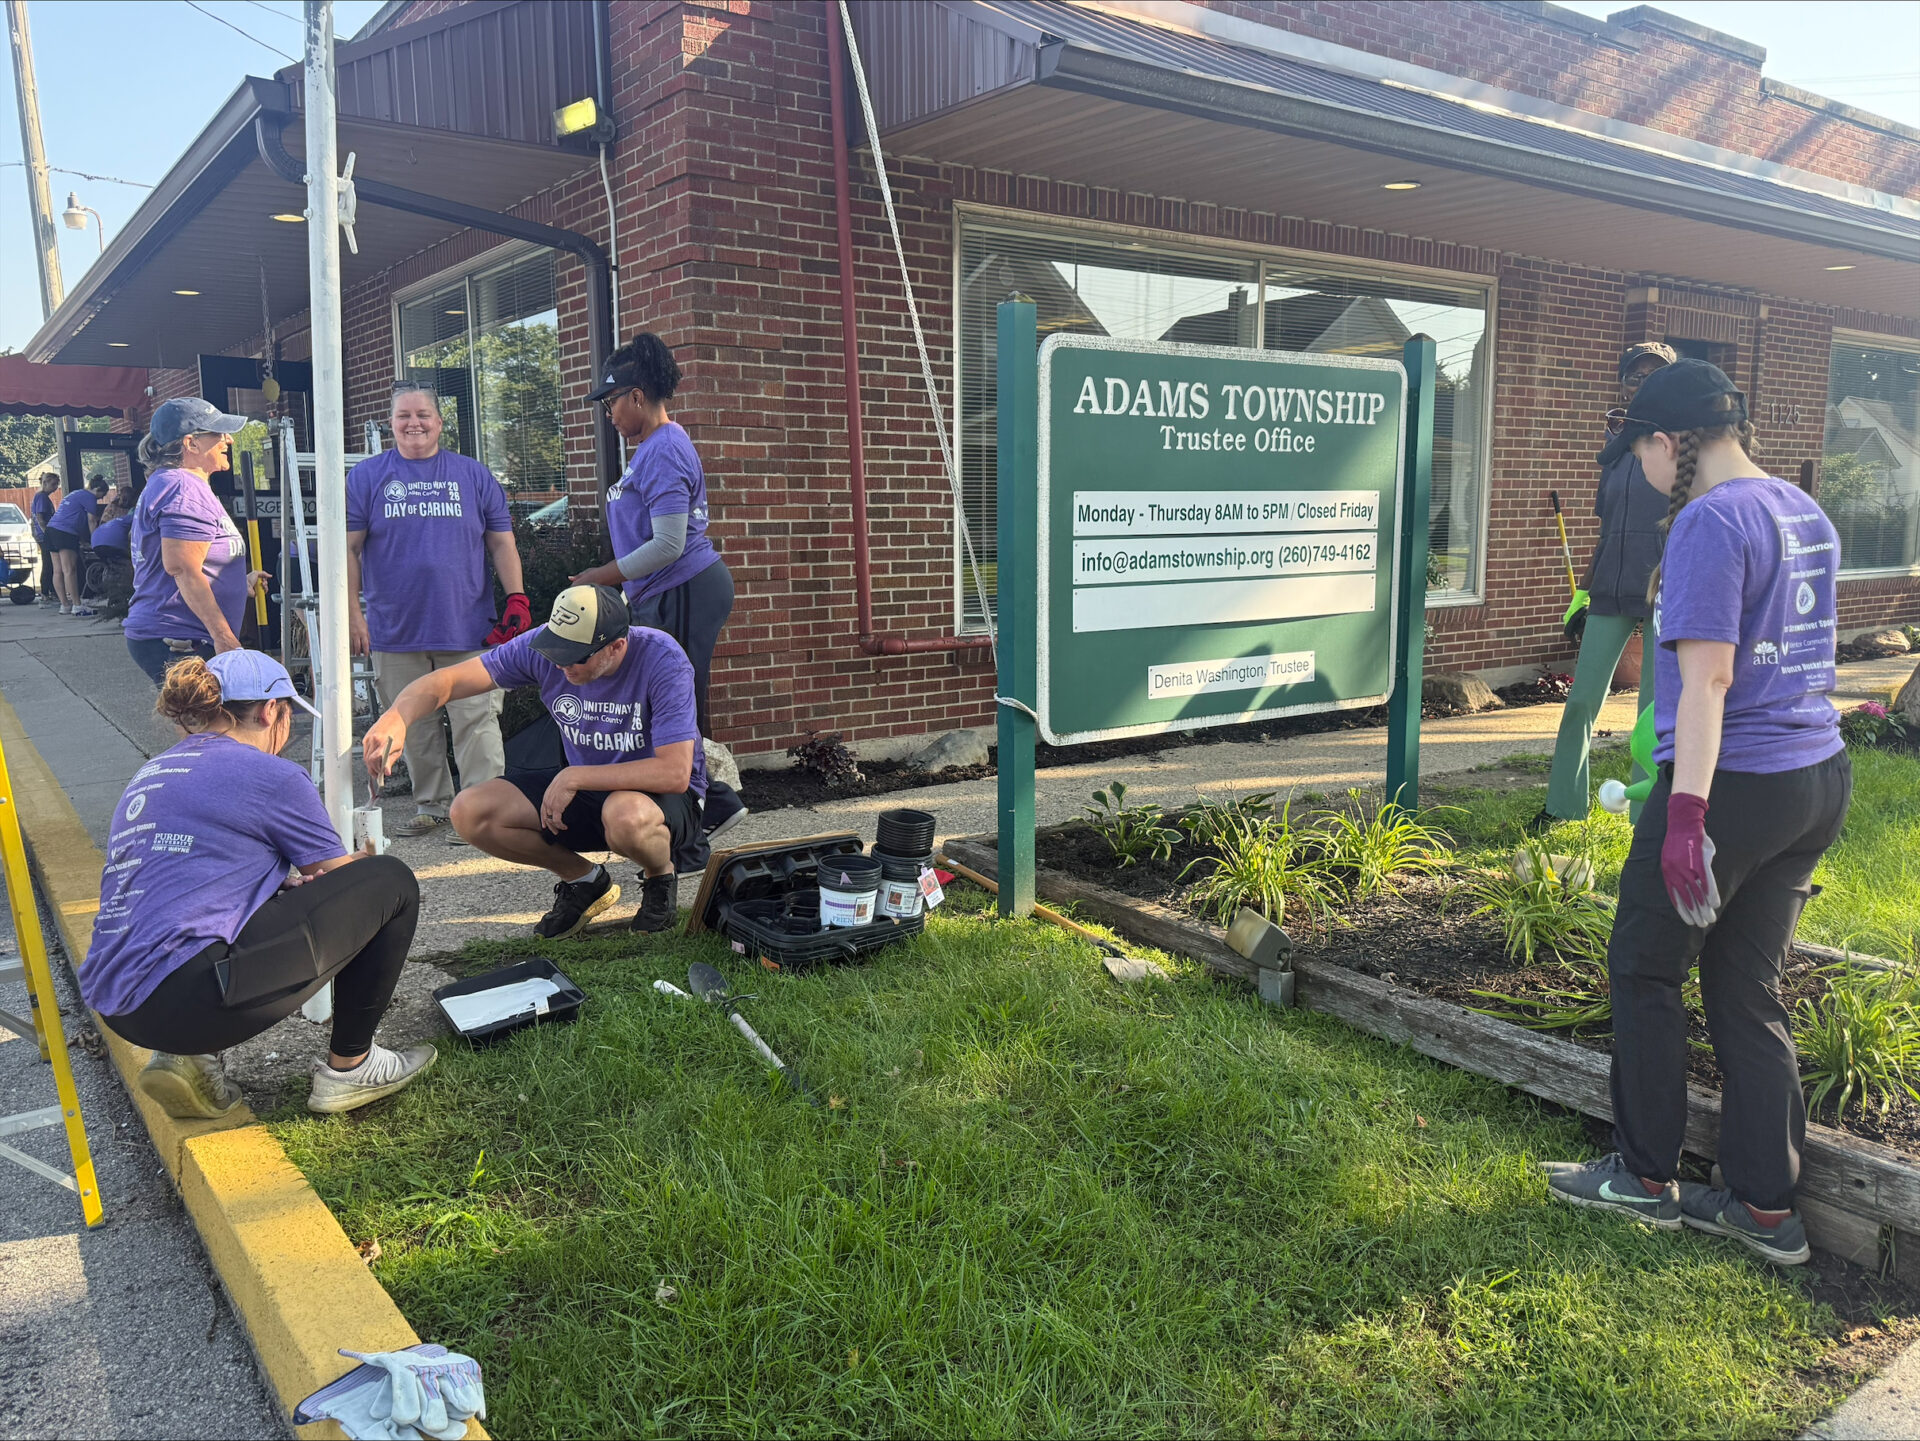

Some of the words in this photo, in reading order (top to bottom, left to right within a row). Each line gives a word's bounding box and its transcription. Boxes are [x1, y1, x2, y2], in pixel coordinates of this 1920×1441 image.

[1073, 375, 1210, 419] ADAMS
[1221, 384, 1385, 425] TOWNSHIP
[1770, 404, 1800, 424] 1125
[1160, 425, 1246, 451] Trustee
[1254, 428, 1315, 452] Office
[408, 481, 432, 490] UNITED
[433, 481, 447, 489] WAY
[448, 481, 458, 491] 20
[236, 501, 281, 514] LRGE
[384, 502, 407, 518] DAY
[408, 505, 418, 515] OF
[419, 502, 463, 517] CARING
[1078, 504, 1135, 526] Monday
[1148, 502, 1211, 524] Thursday
[1214, 504, 1243, 520] 8AM
[1247, 505, 1259, 520] to
[1262, 503, 1289, 519] 5PM
[1297, 502, 1336, 519] Closed
[1340, 502, 1374, 522] Friday
[1081, 548, 1274, 574] info@adamstownship.org
[1278, 544, 1371, 568] (260)749-4162
[1753, 651, 1779, 665] aid
[1154, 671, 1193, 689] Denita
[1196, 664, 1268, 685] Washington,
[1270, 658, 1310, 676] Trustee
[583, 699, 615, 713] UNITED
[582, 713, 599, 721] Allen
[601, 714, 623, 725] County
[631, 717, 643, 731] 26
[580, 734, 591, 746] OF
[594, 731, 645, 752] CARING
[154, 833, 195, 843] PURDUE
